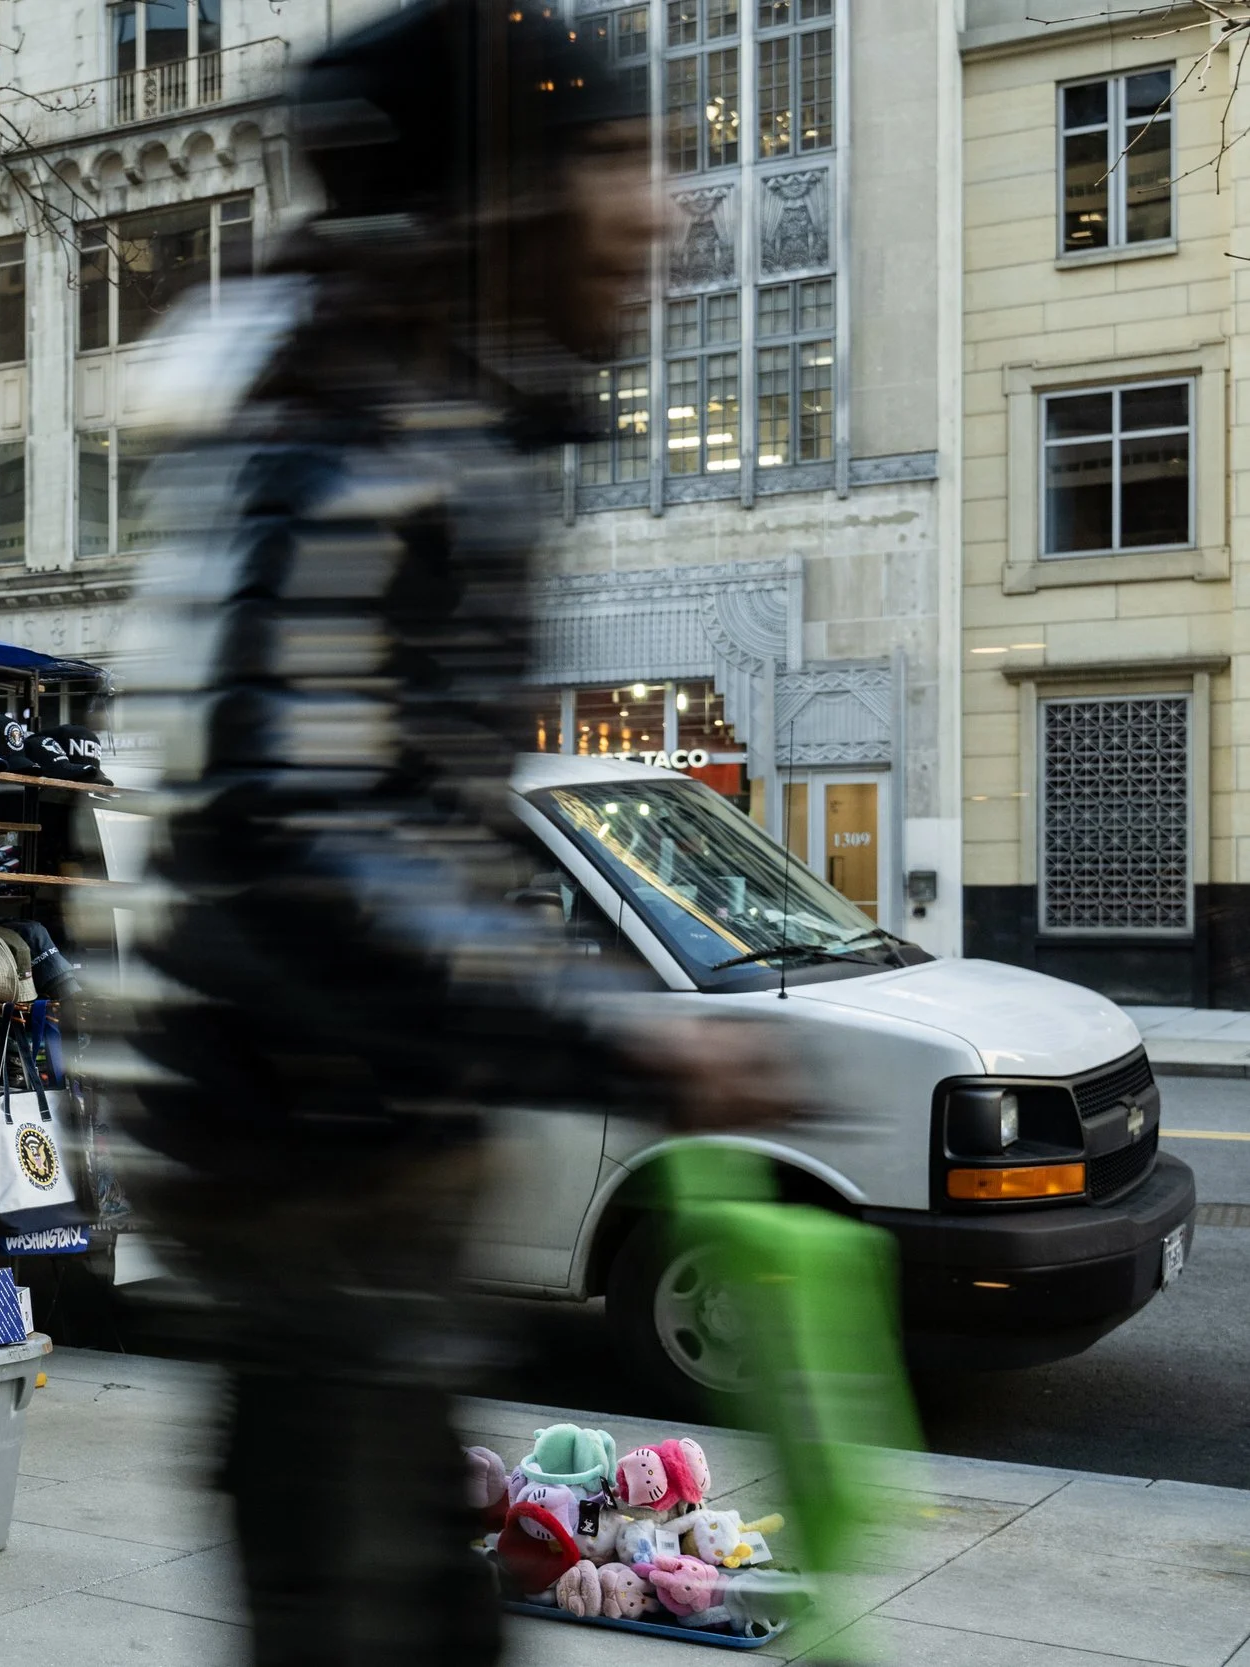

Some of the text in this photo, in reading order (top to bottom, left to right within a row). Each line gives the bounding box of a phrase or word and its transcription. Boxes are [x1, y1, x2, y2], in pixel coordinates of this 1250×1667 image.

[638, 748, 710, 770] TACO
[833, 831, 871, 848] 1309
[5, 1226, 71, 1251] WASHINGTON
